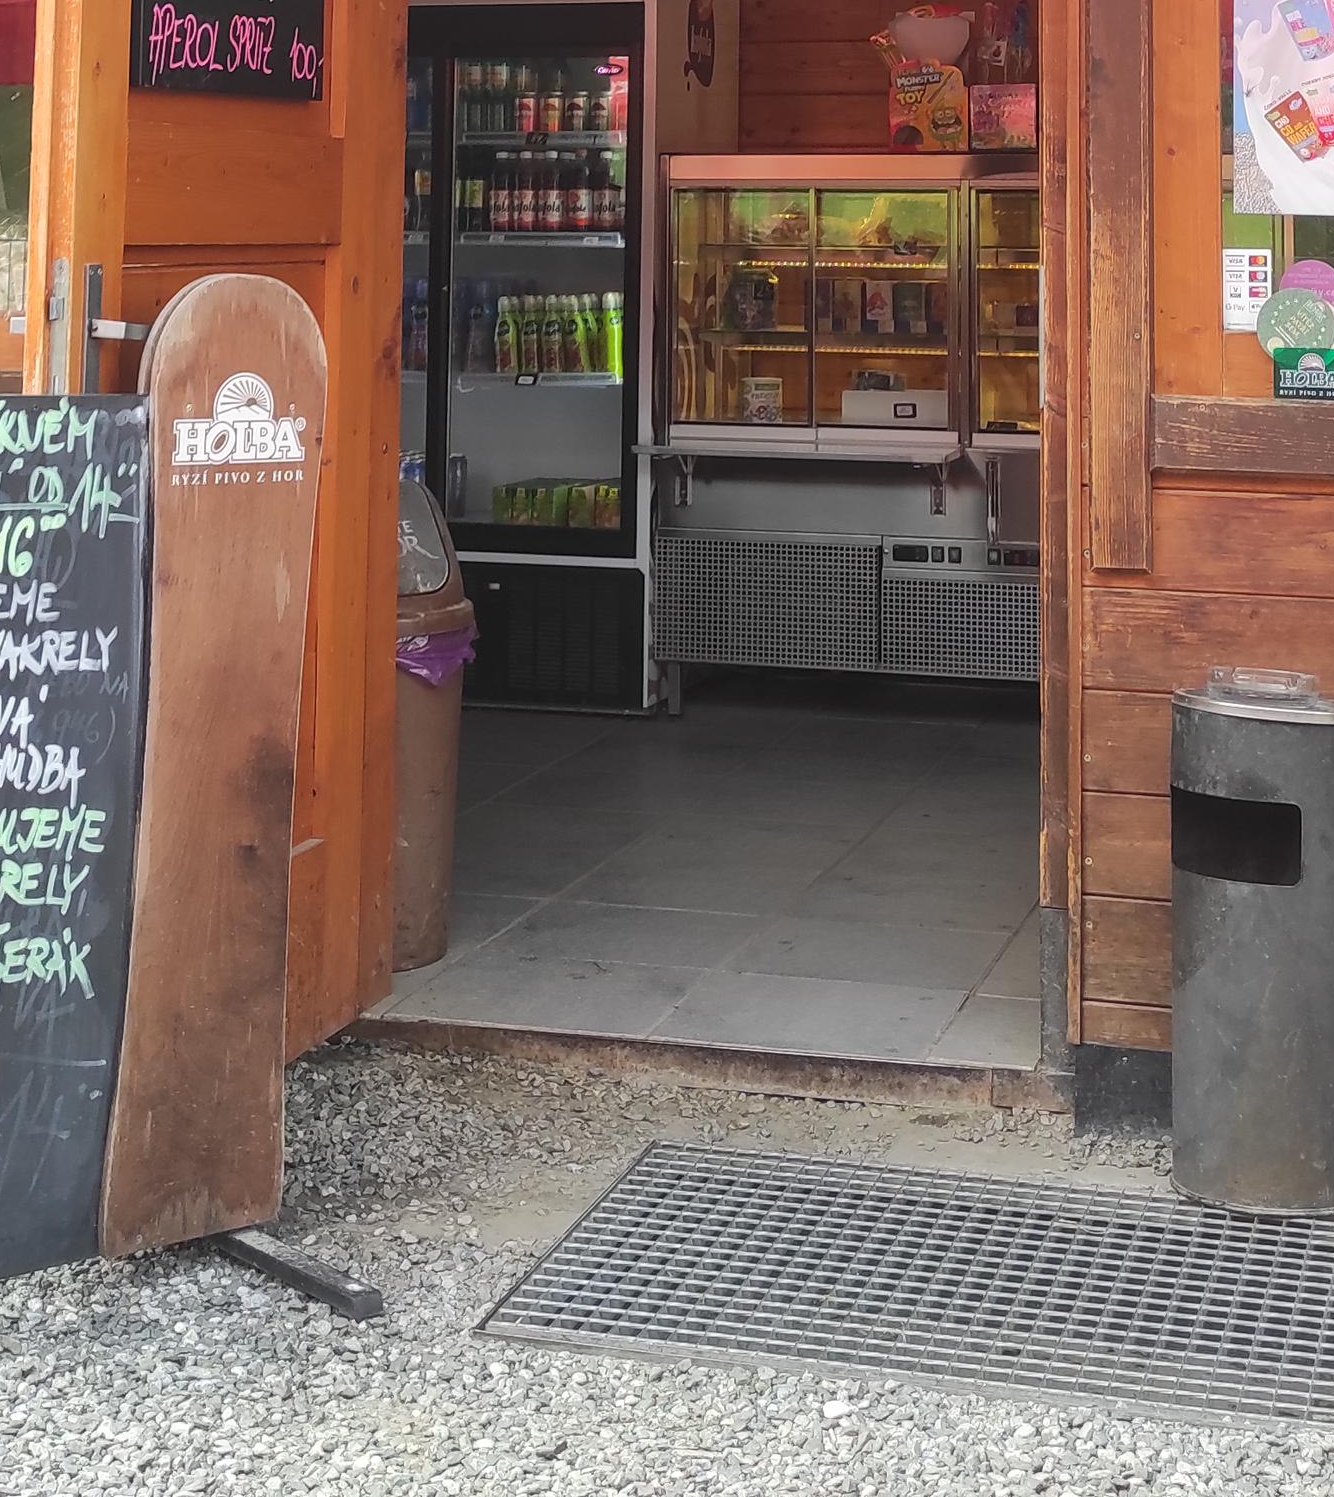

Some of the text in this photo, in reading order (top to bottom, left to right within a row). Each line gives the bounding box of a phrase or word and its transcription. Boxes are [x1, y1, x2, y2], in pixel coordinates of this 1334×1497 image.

[149, 3, 223, 86] APEROL
[896, 71, 944, 89] MONSTER
[896, 90, 925, 106] TOY
[172, 417, 306, 466] HOLBA
[28, 465, 66, 504] OD
[171, 469, 304, 486] RYZÍ PIVO Z HOR
